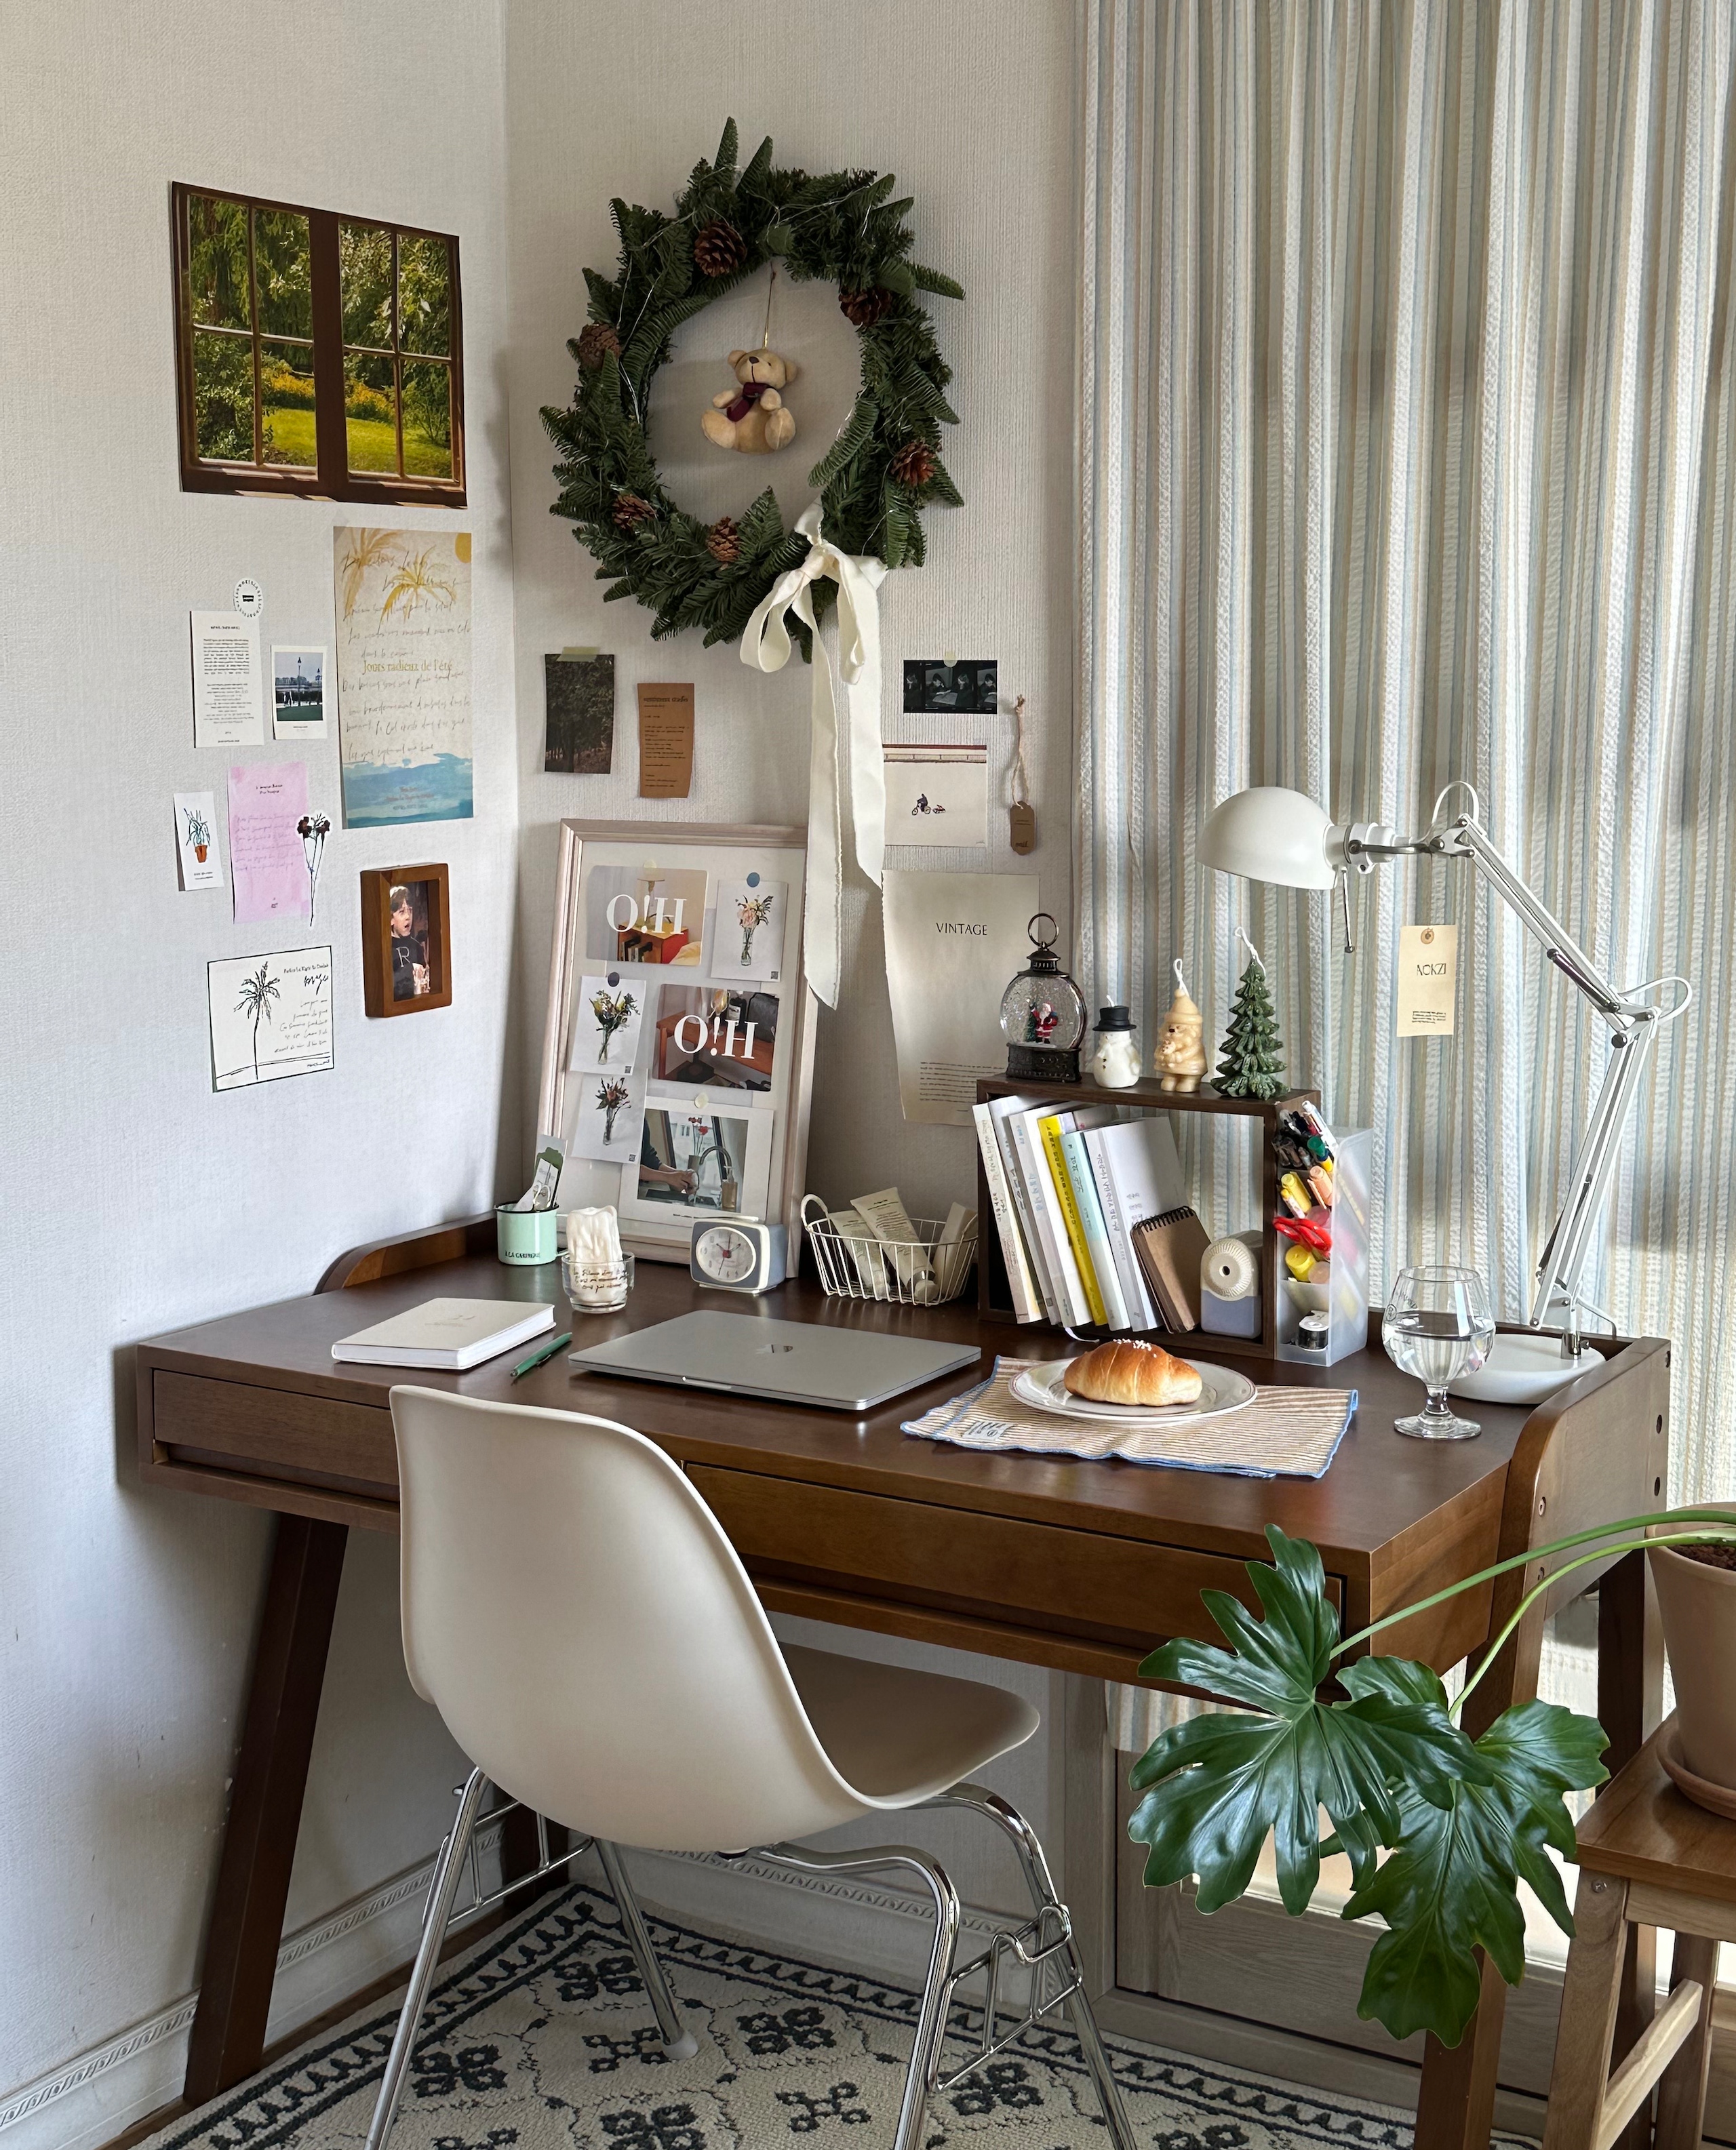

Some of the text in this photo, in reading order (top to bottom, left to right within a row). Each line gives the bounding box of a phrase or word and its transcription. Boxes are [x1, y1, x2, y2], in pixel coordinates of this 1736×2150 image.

[606, 894, 687, 935] O!H
[936, 922, 987, 936] VINTAGE
[395, 946, 411, 968] R
[674, 1014, 759, 1060] O!H
